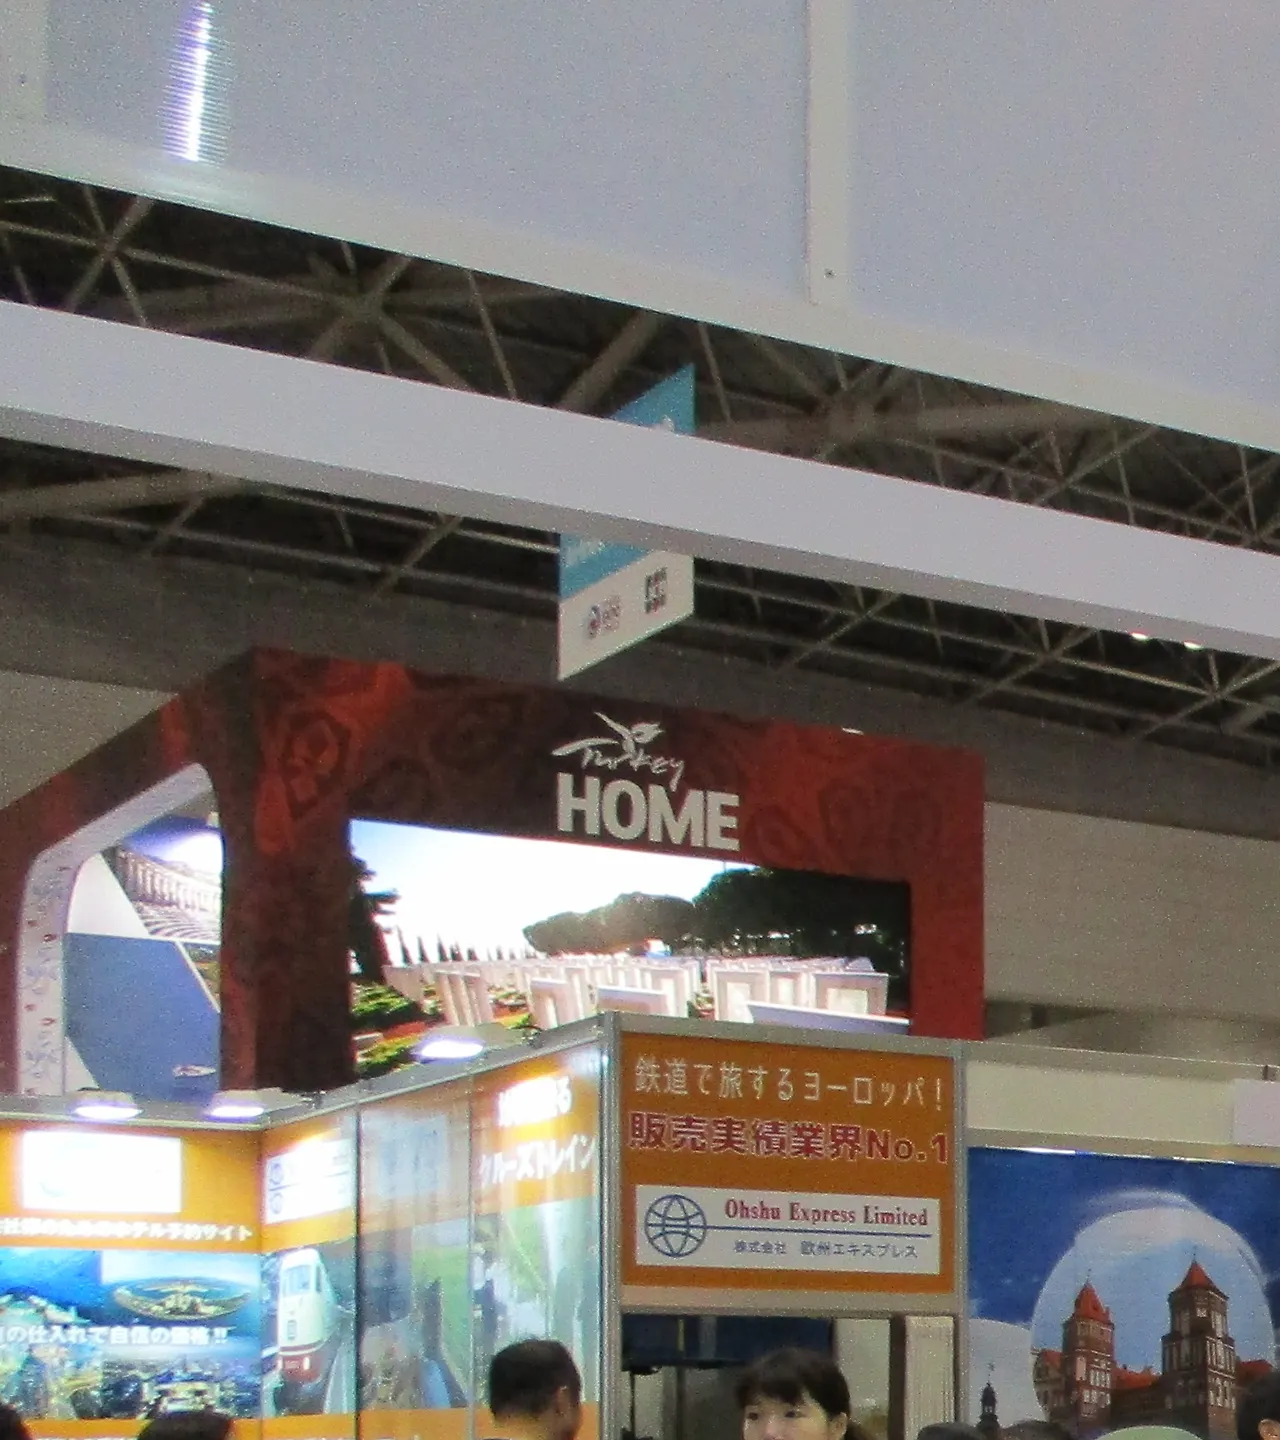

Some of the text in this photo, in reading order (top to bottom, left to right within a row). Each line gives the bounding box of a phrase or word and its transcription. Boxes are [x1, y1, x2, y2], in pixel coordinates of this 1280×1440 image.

[557, 772, 740, 851] HOME
[627, 1110, 949, 1165] 販売実績業界No.1
[724, 1199, 929, 1227] Ohshu Express Limited
[733, 1239, 787, 1255] 株式会社
